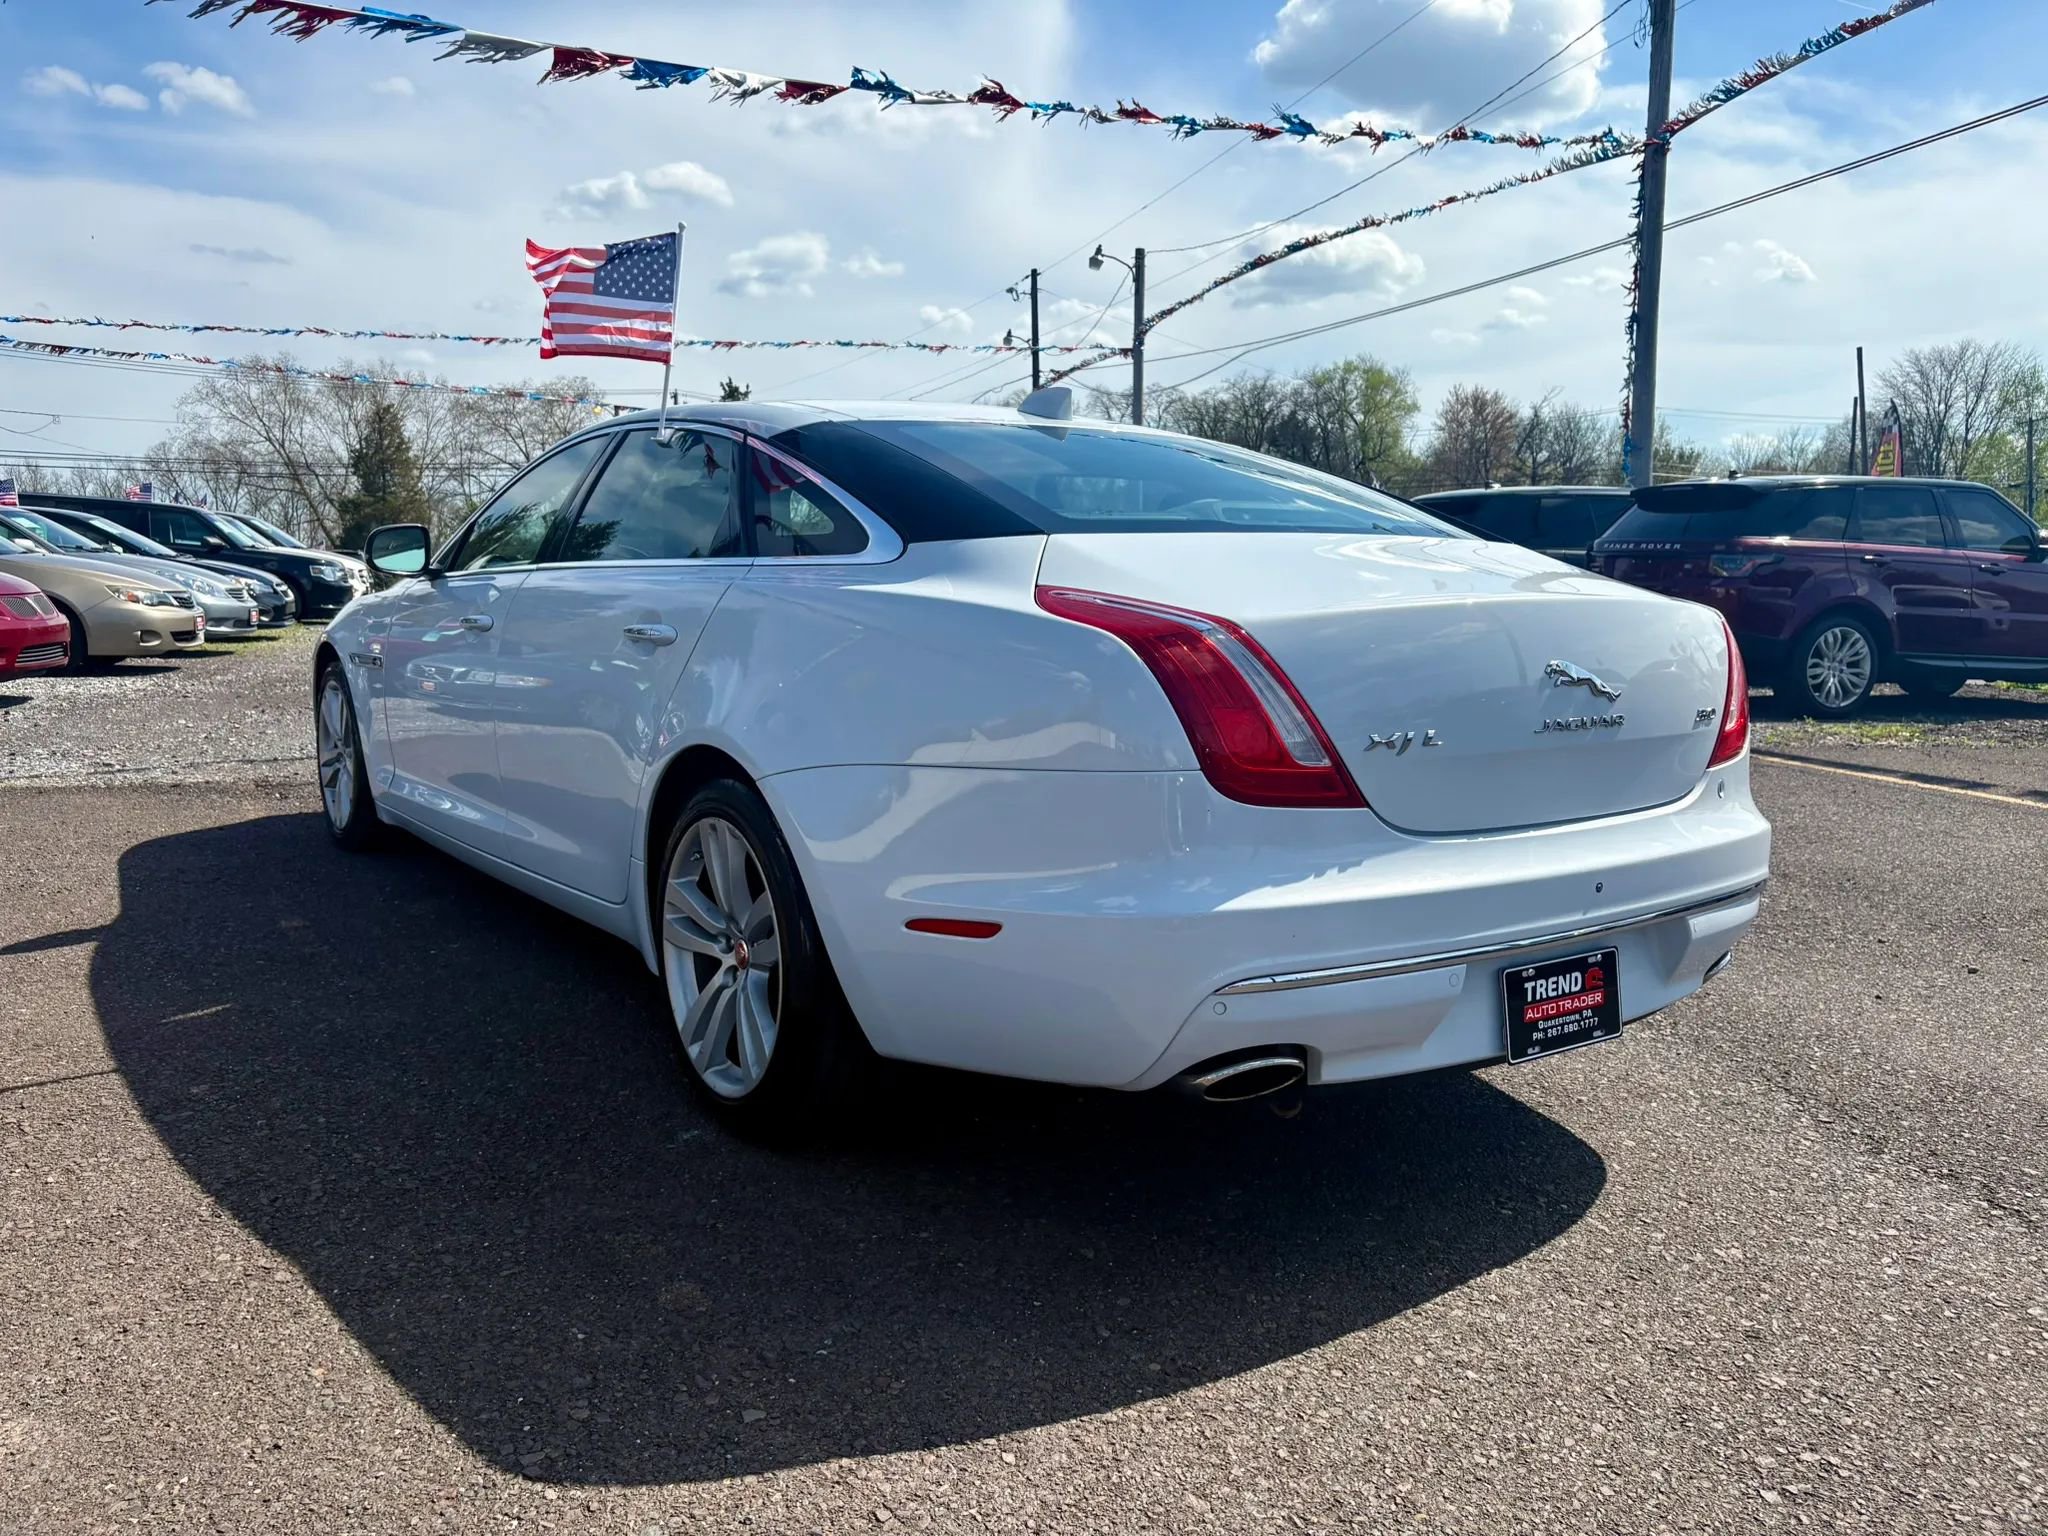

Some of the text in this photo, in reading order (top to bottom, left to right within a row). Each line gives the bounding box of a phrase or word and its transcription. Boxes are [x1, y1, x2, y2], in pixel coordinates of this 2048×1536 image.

[1603, 542, 1681, 550] RANGE ROVER
[1534, 714, 1625, 734] JAGUAR
[1524, 971, 1582, 1002] TREND
[1526, 992, 1602, 1020] AUTO TRADER
[1582, 1009, 1592, 1018] PA
[1532, 1031, 1545, 1041] PH:
